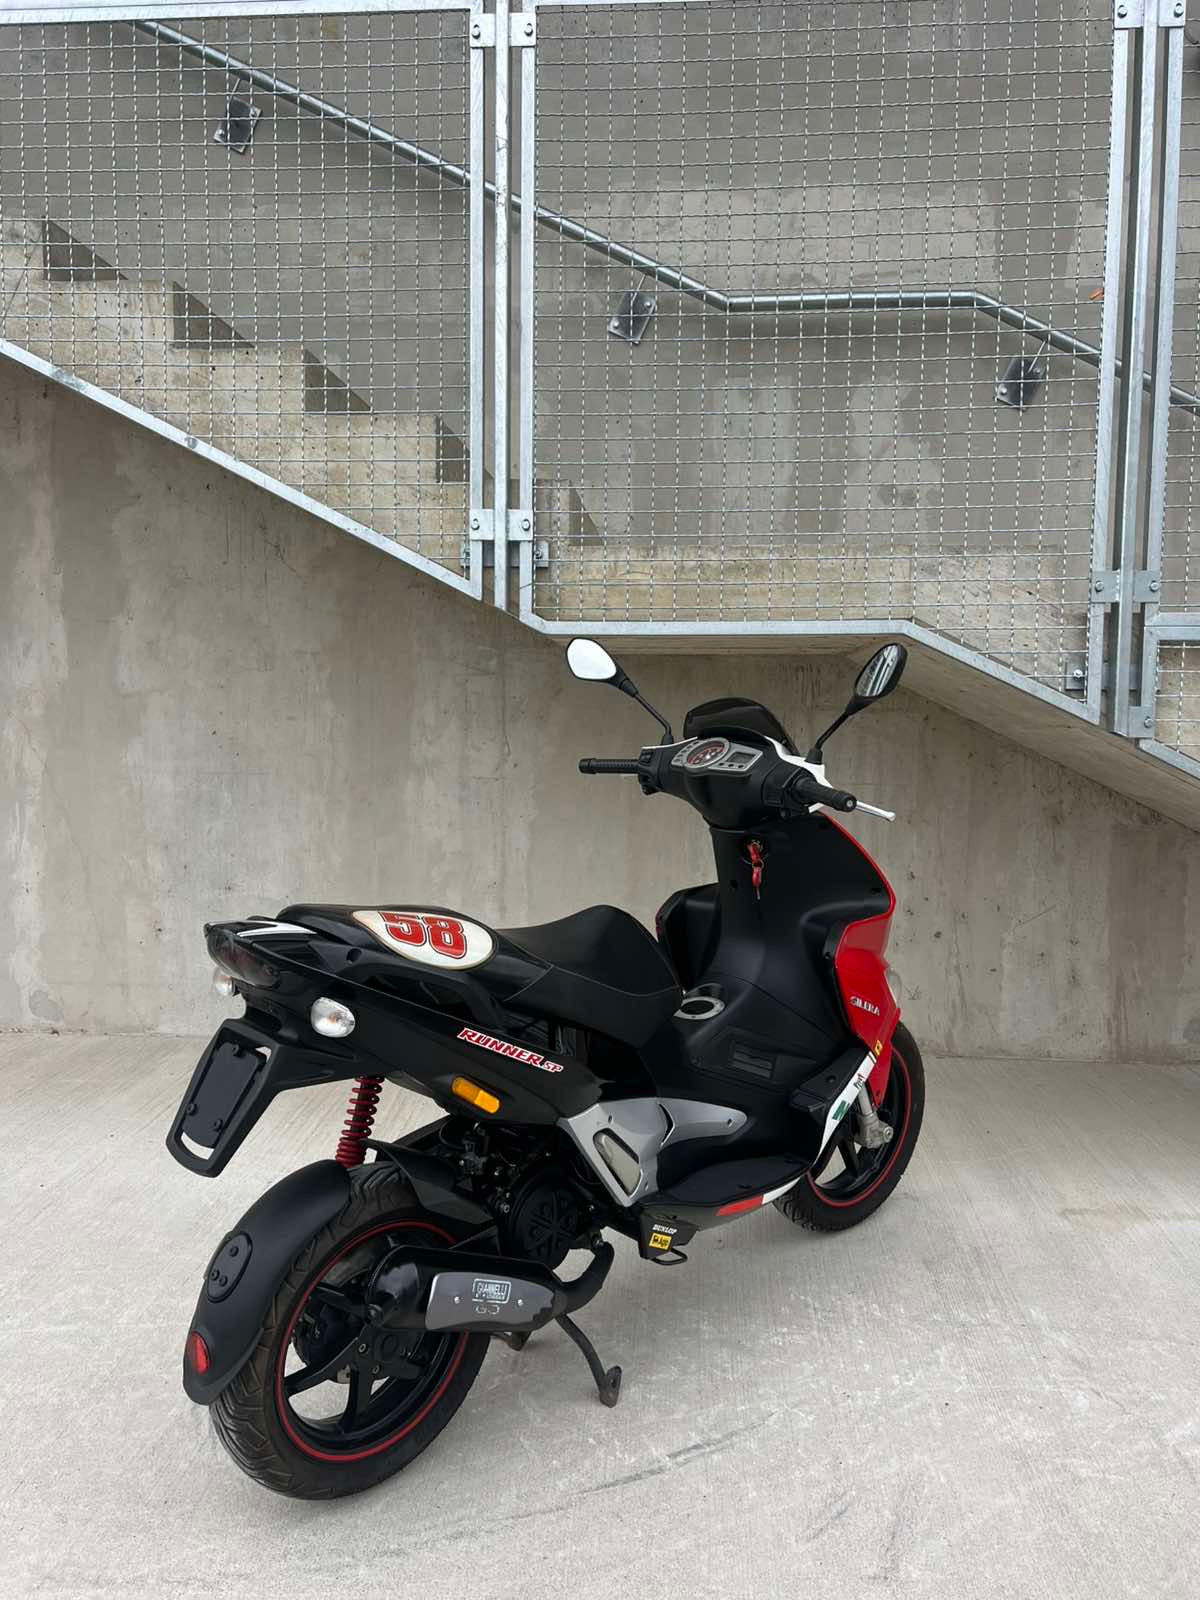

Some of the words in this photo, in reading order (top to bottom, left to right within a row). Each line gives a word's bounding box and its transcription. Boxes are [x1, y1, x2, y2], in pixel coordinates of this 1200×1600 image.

[378, 911, 467, 959] 58
[457, 1027, 544, 1068] RUNNER
[543, 1060, 564, 1072] SP
